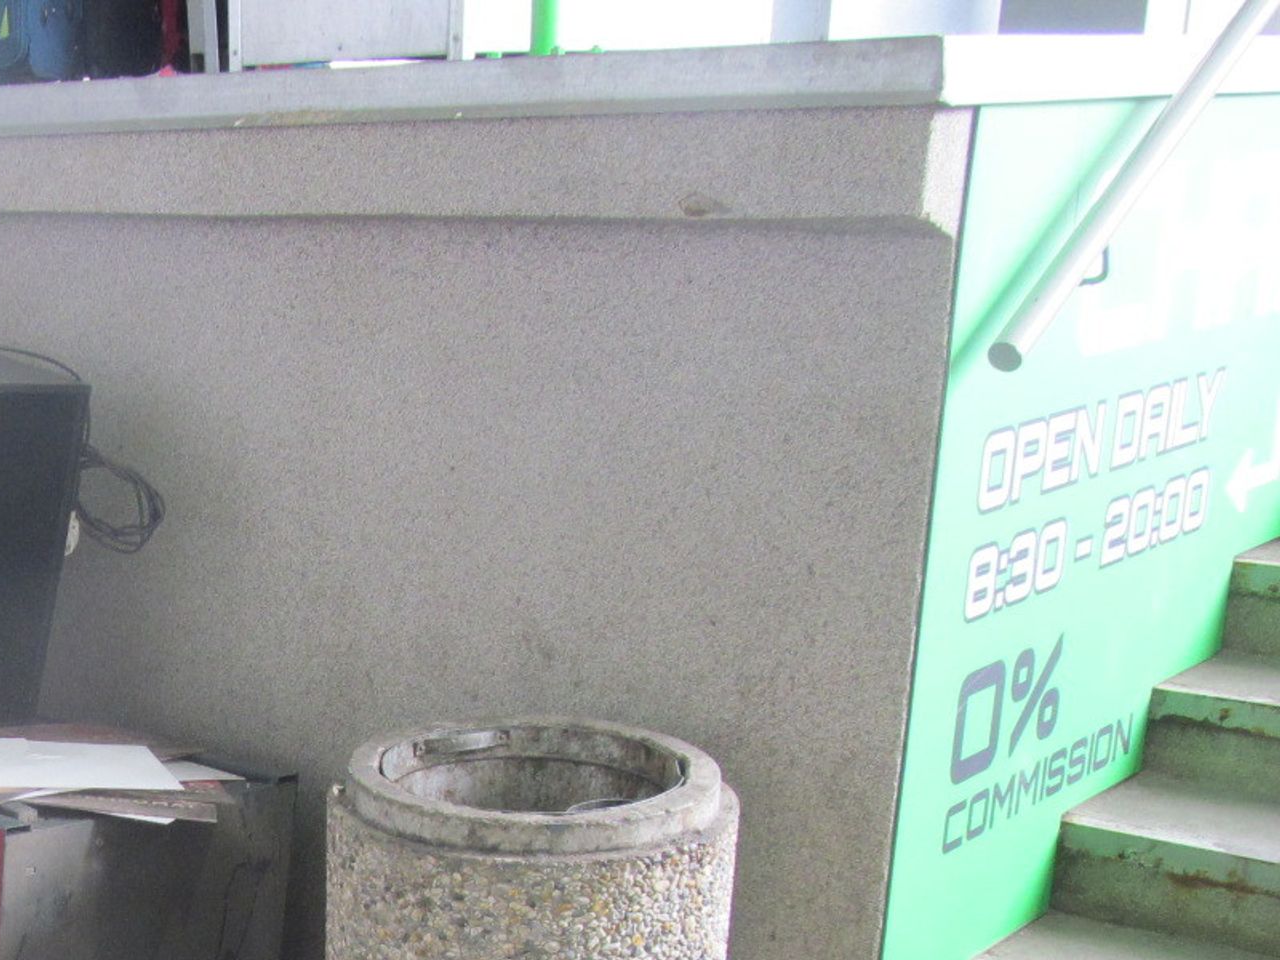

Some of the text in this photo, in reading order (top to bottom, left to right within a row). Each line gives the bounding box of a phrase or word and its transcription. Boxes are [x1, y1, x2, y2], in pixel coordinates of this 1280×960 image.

[977, 365, 1227, 515] OPEN DAILY
[963, 516, 1068, 623] 8:30
[1098, 465, 1210, 570] 20:00
[941, 712, 1134, 854] COMMISSION
[950, 632, 1065, 785] 0%
